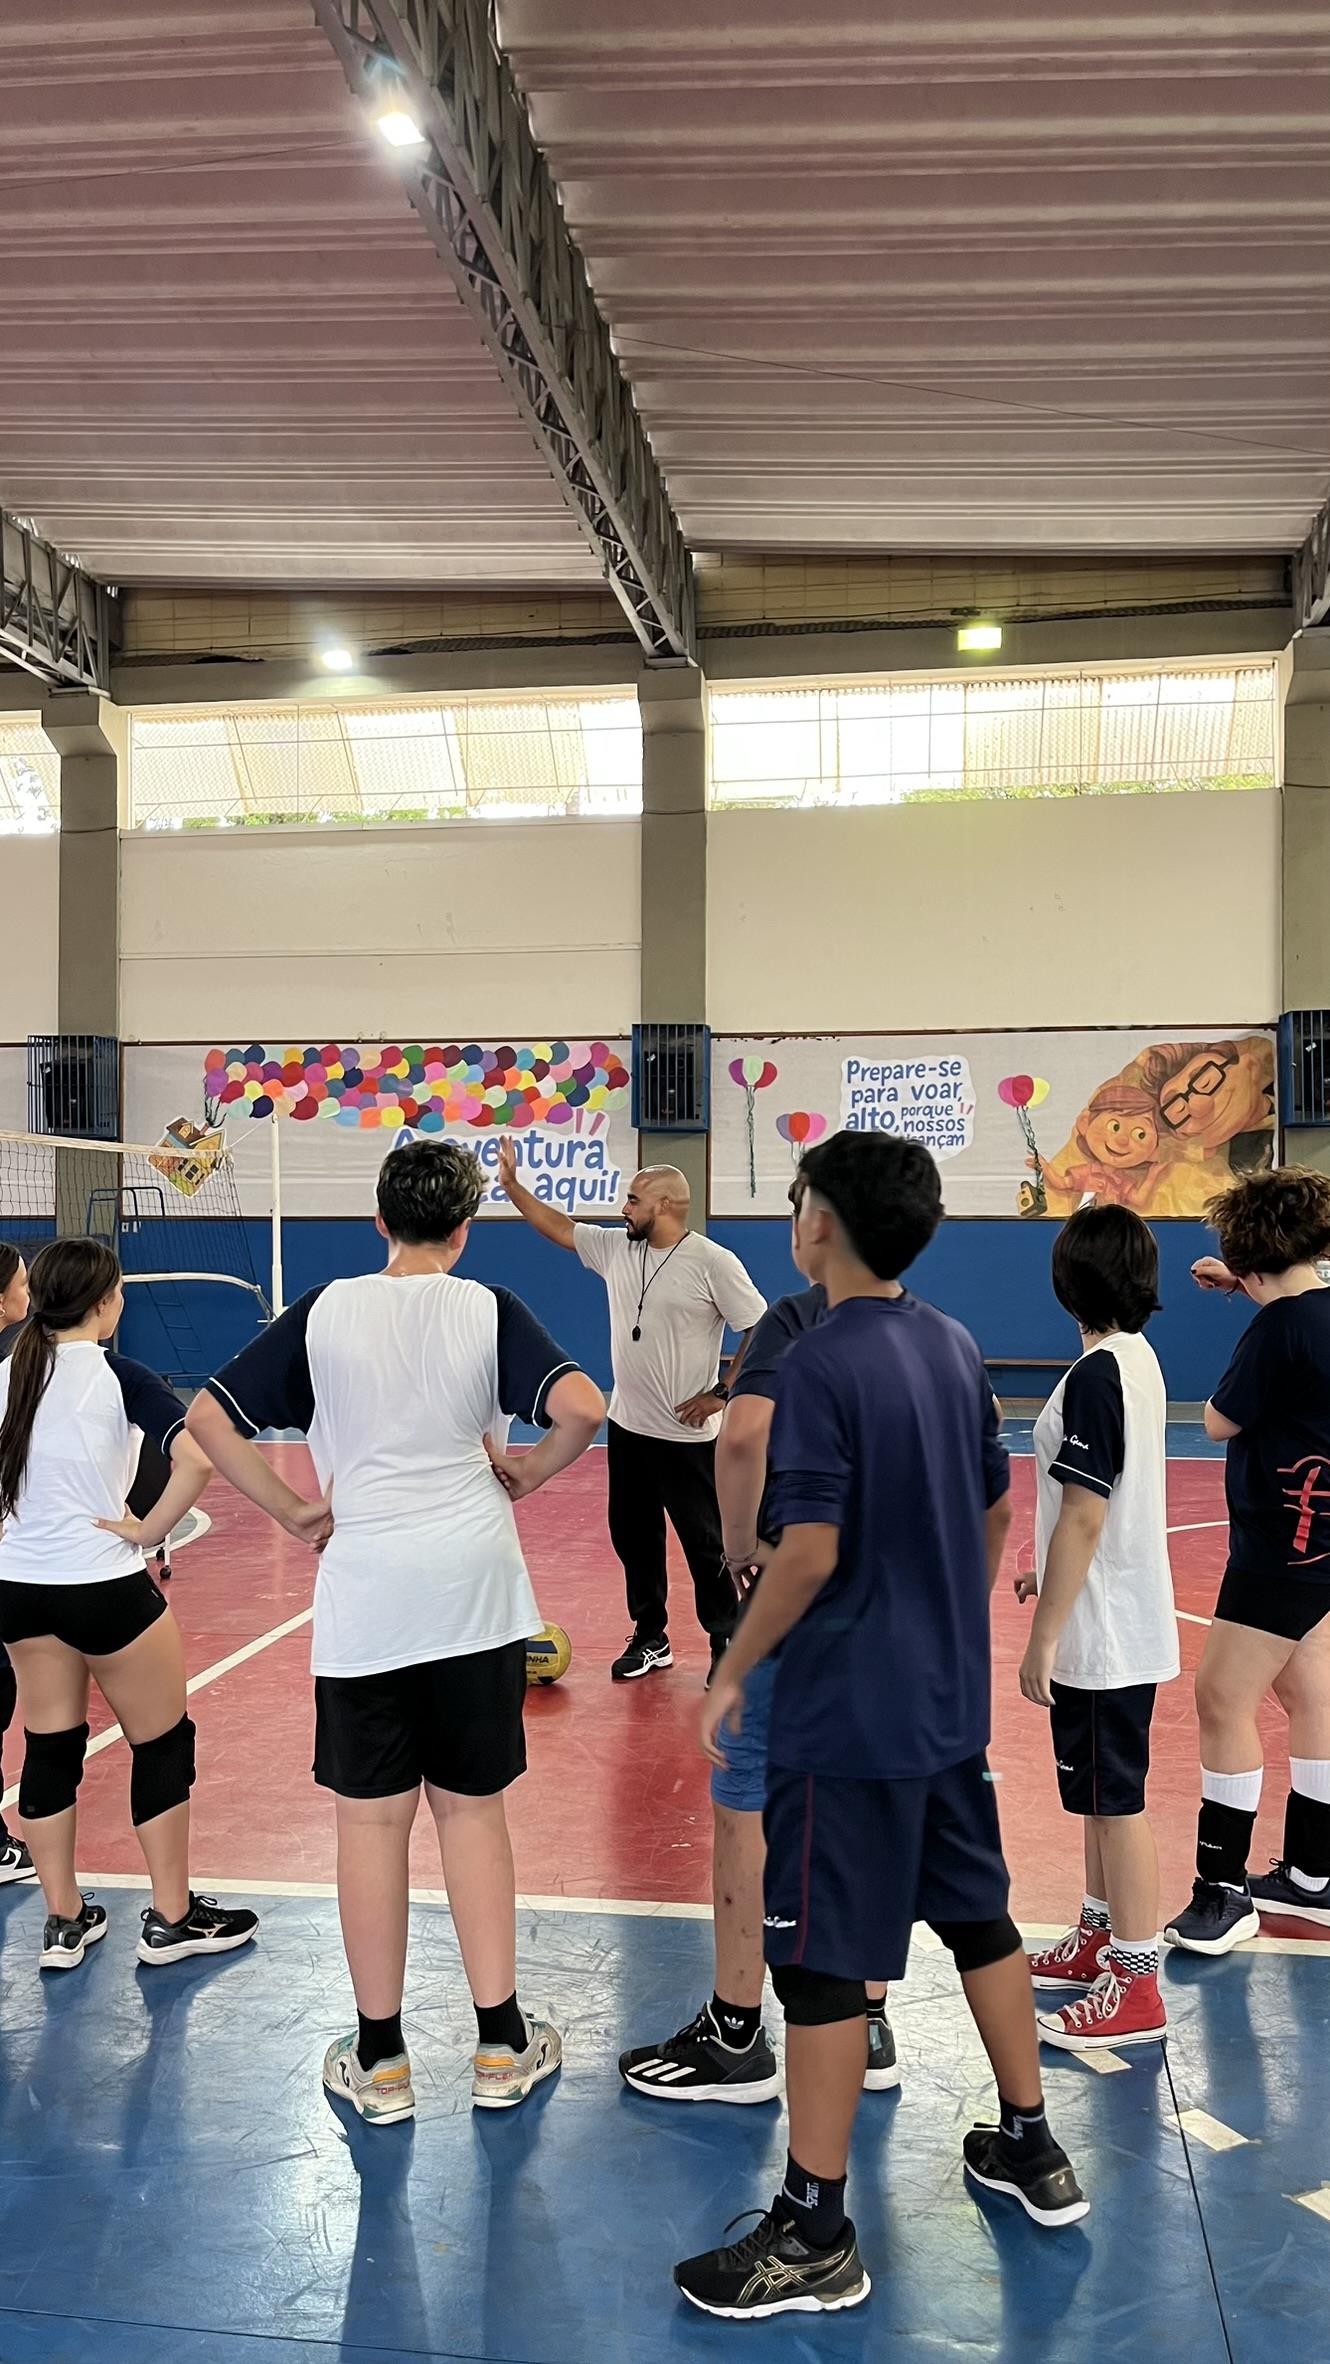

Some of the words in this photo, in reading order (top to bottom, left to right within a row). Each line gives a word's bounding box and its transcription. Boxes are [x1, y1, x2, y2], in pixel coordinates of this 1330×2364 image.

[847, 1060, 961, 1086] Prepare-se
[851, 1087, 899, 1109] para
[911, 1082, 963, 1102] voar,
[845, 1107, 900, 1133] alto,
[901, 1104, 954, 1120] porque
[904, 1118, 965, 1132] nossos
[534, 1170, 620, 1213] aqui!
